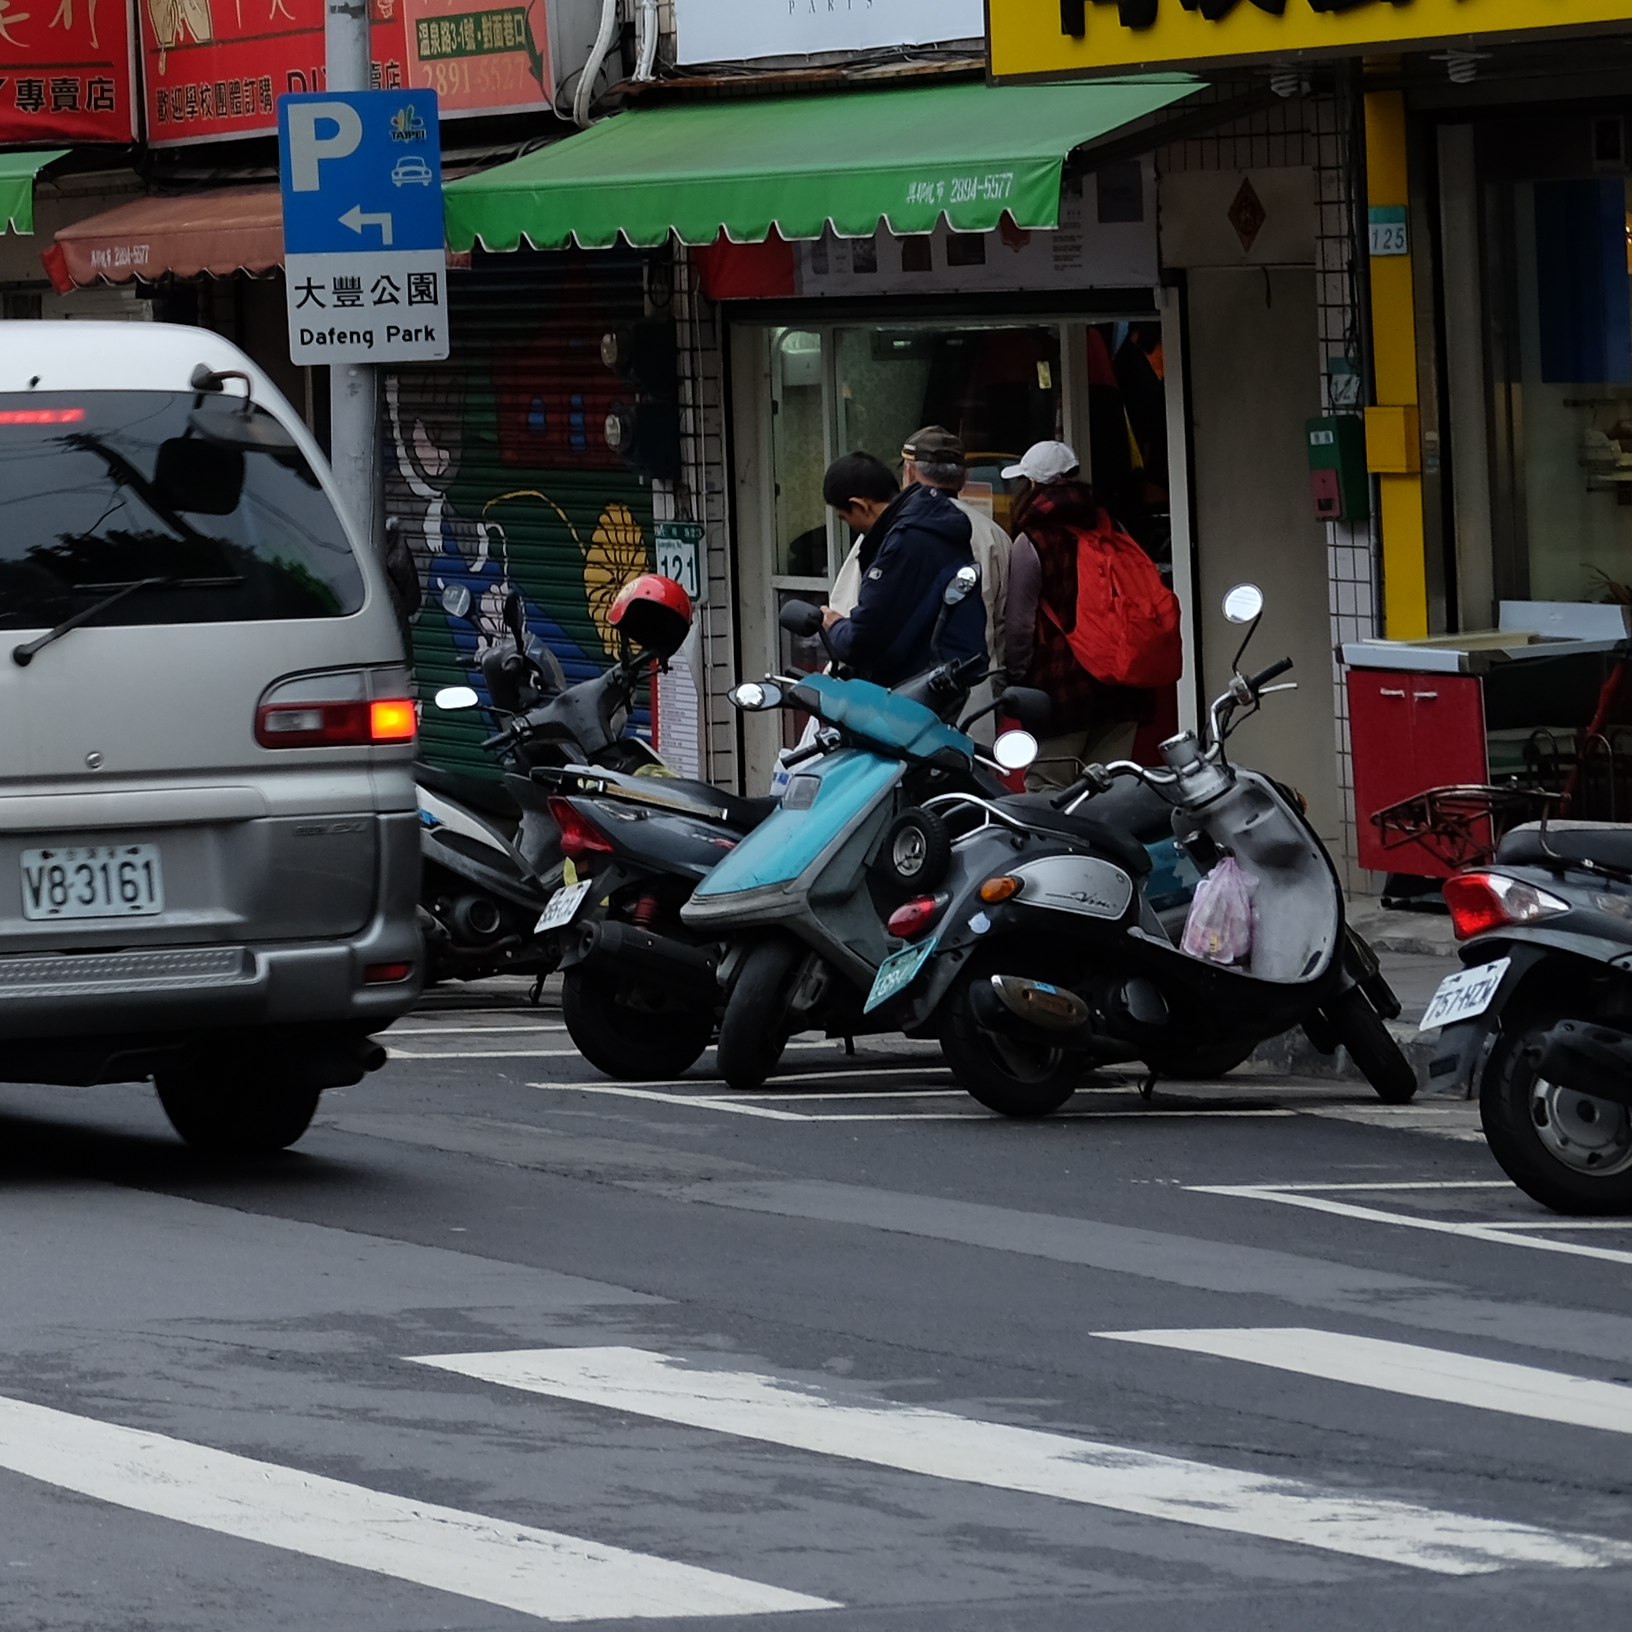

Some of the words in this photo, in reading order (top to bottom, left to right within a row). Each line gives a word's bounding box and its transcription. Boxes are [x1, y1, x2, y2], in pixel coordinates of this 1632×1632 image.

[288, 101, 363, 192] P
[390, 129, 426, 141] TAIPEI
[950, 172, 1014, 203] 2894-5577
[1372, 226, 1405, 250] 125
[294, 271, 439, 310] 大豐公園
[299, 326, 374, 349] Dafeng
[386, 324, 436, 343] Park
[25, 862, 158, 909] V8-3161
